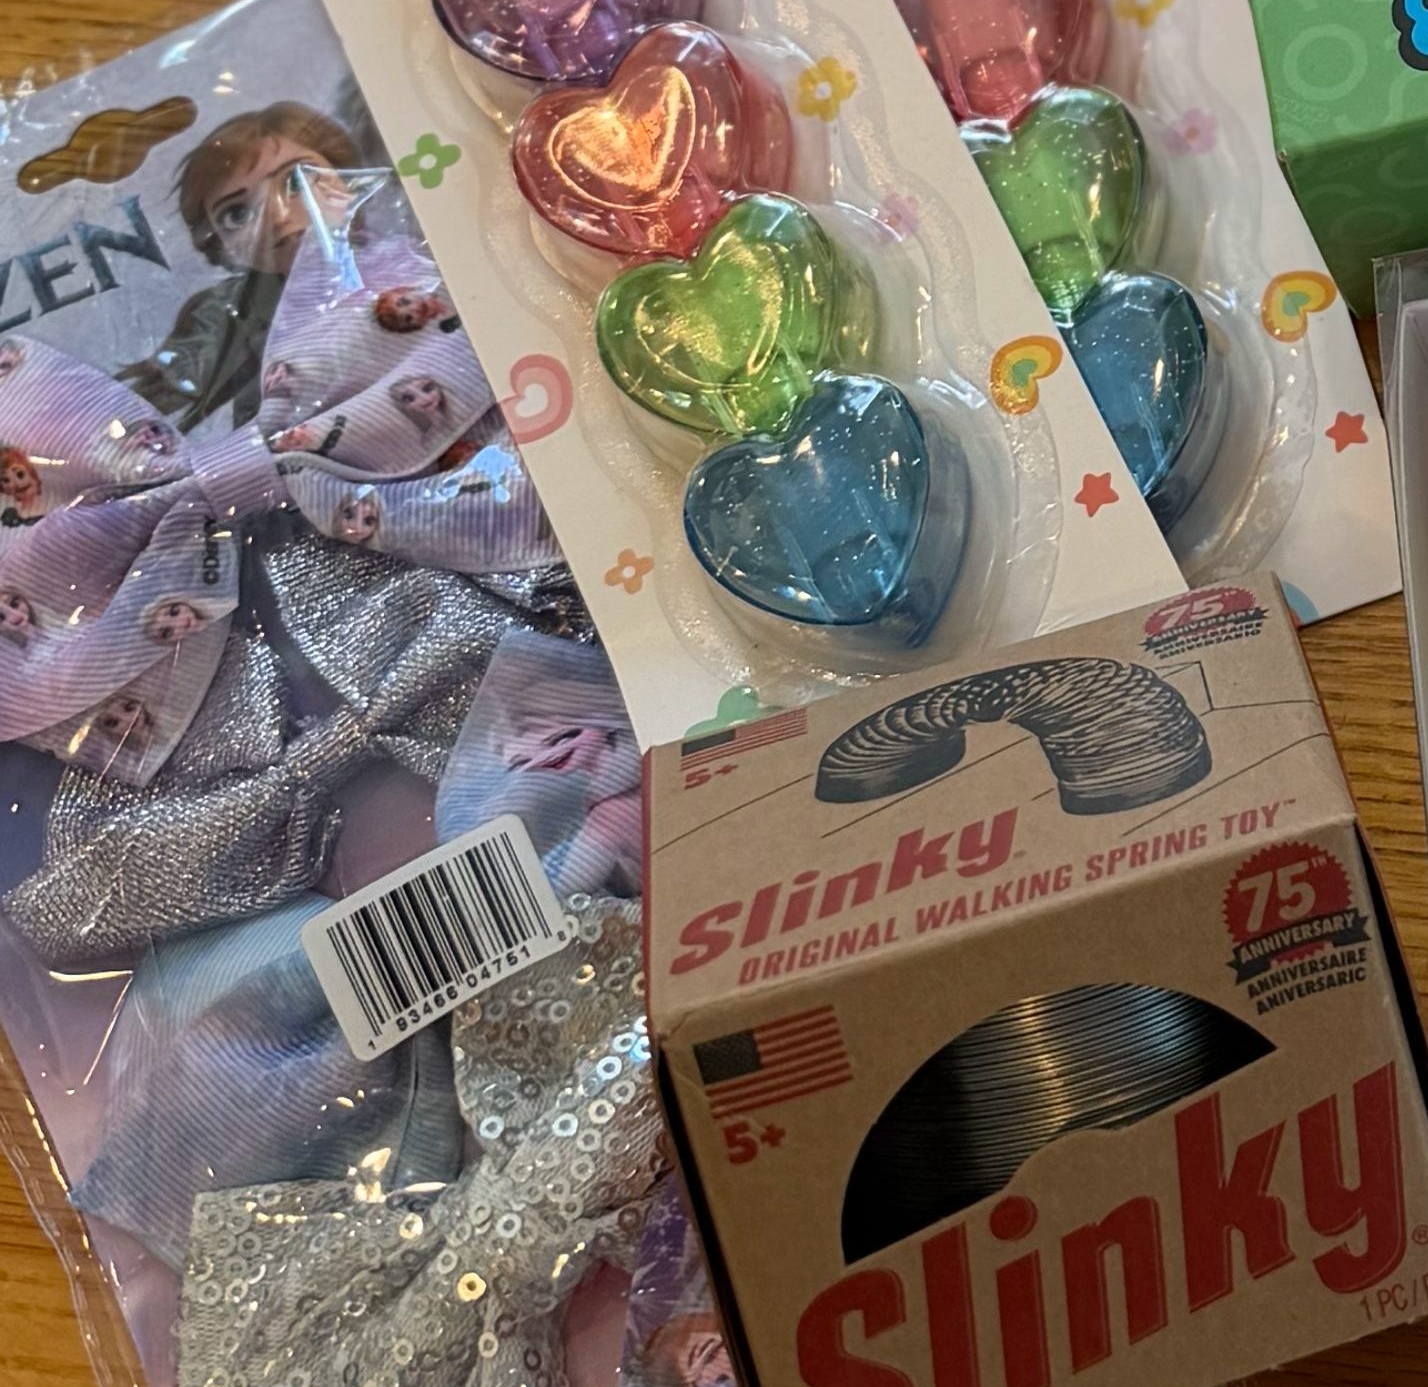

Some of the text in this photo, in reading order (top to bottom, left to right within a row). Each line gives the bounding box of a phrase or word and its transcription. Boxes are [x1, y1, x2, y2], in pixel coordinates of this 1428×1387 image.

[684, 763, 739, 790] 5+
[669, 806, 1021, 979] Slinky
[737, 915, 901, 987] ORIGINAL
[915, 862, 1074, 934] WALKING
[1084, 824, 1209, 882] SPRING
[1239, 915, 1357, 963] ANNIVERSARY
[367, 1039, 379, 1051] 1
[395, 984, 460, 1032] 93466
[465, 944, 533, 990] 04751
[1247, 947, 1368, 999] ANNIVERSAIRE
[722, 1119, 787, 1166] 5+
[1360, 1295, 1372, 1322] 1
